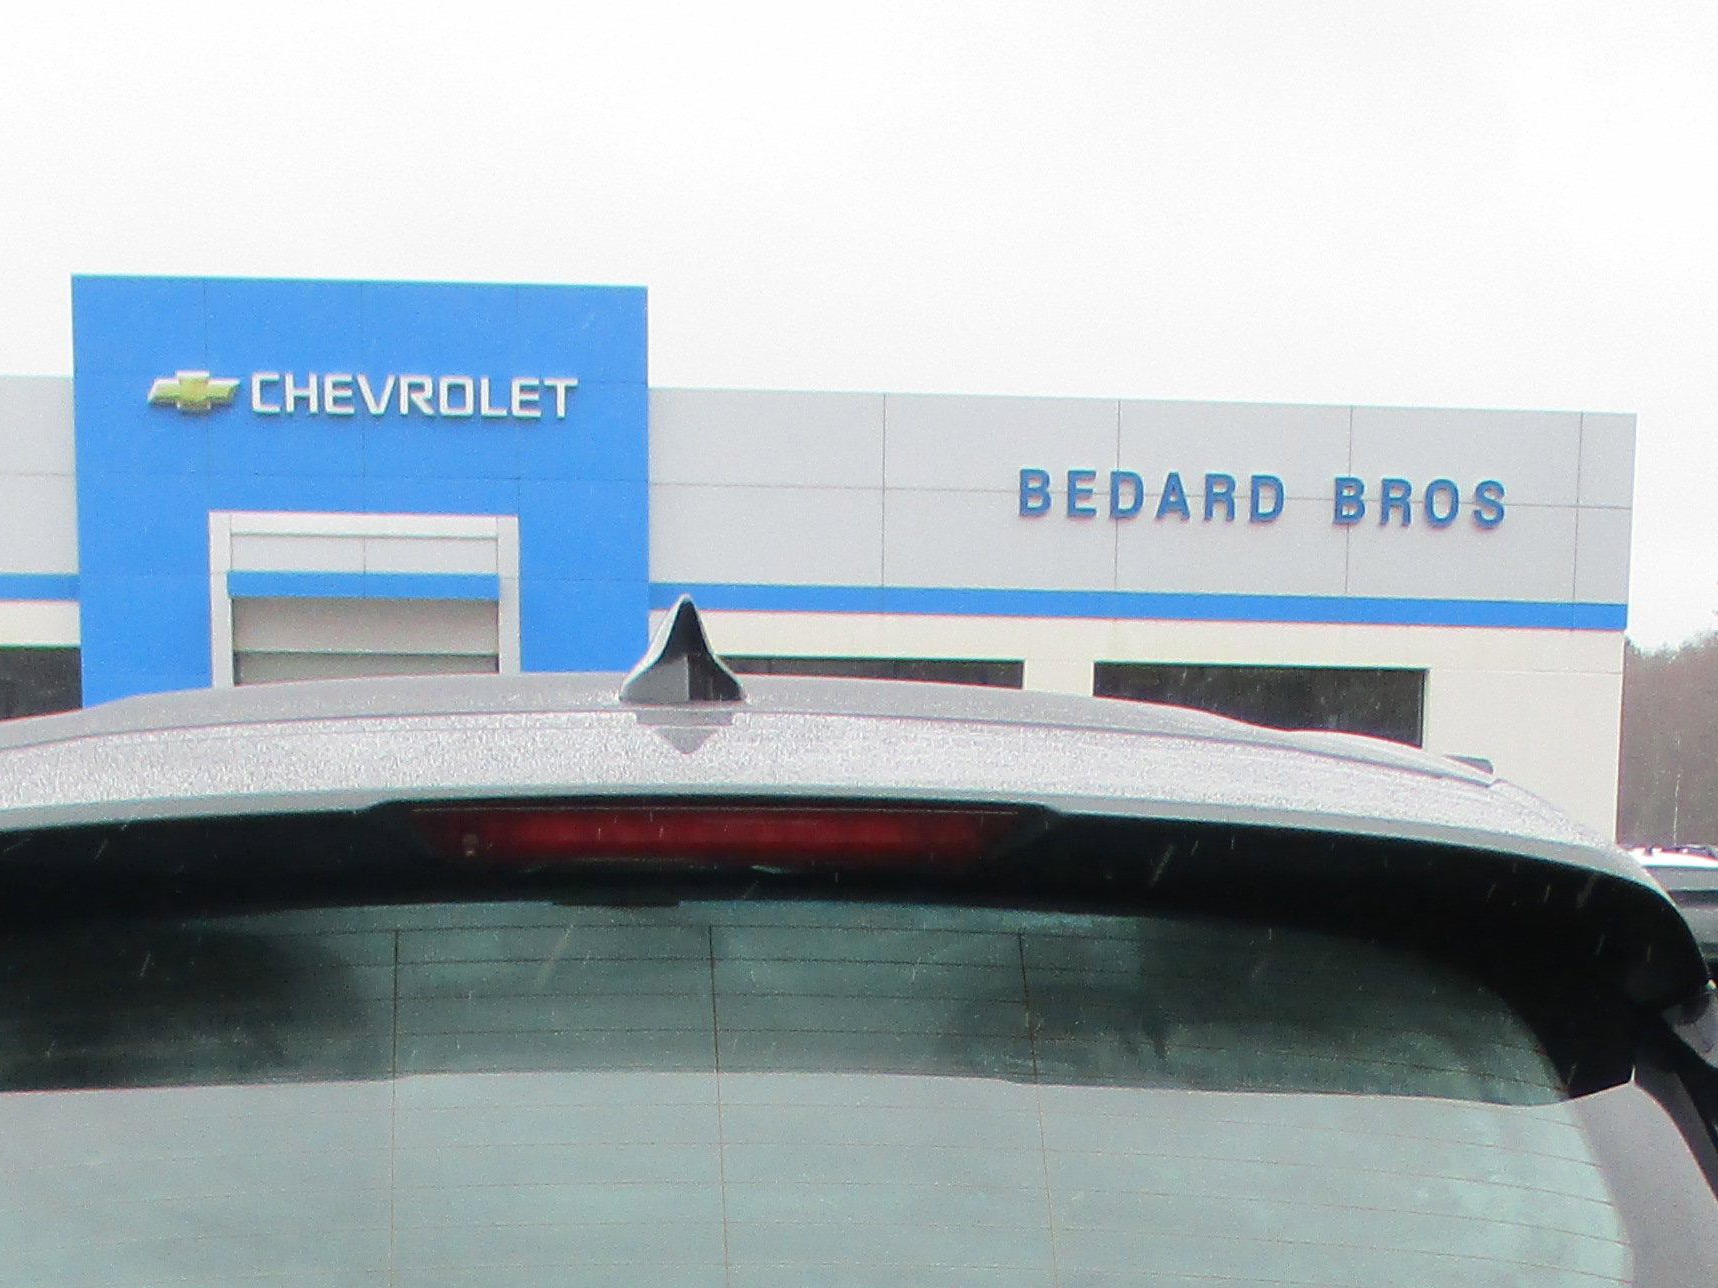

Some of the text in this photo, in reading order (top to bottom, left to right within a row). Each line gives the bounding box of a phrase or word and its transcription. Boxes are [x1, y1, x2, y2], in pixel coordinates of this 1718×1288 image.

[250, 371, 579, 420] CHEVROLET
[1018, 467, 1506, 529] BEDARD BROS
